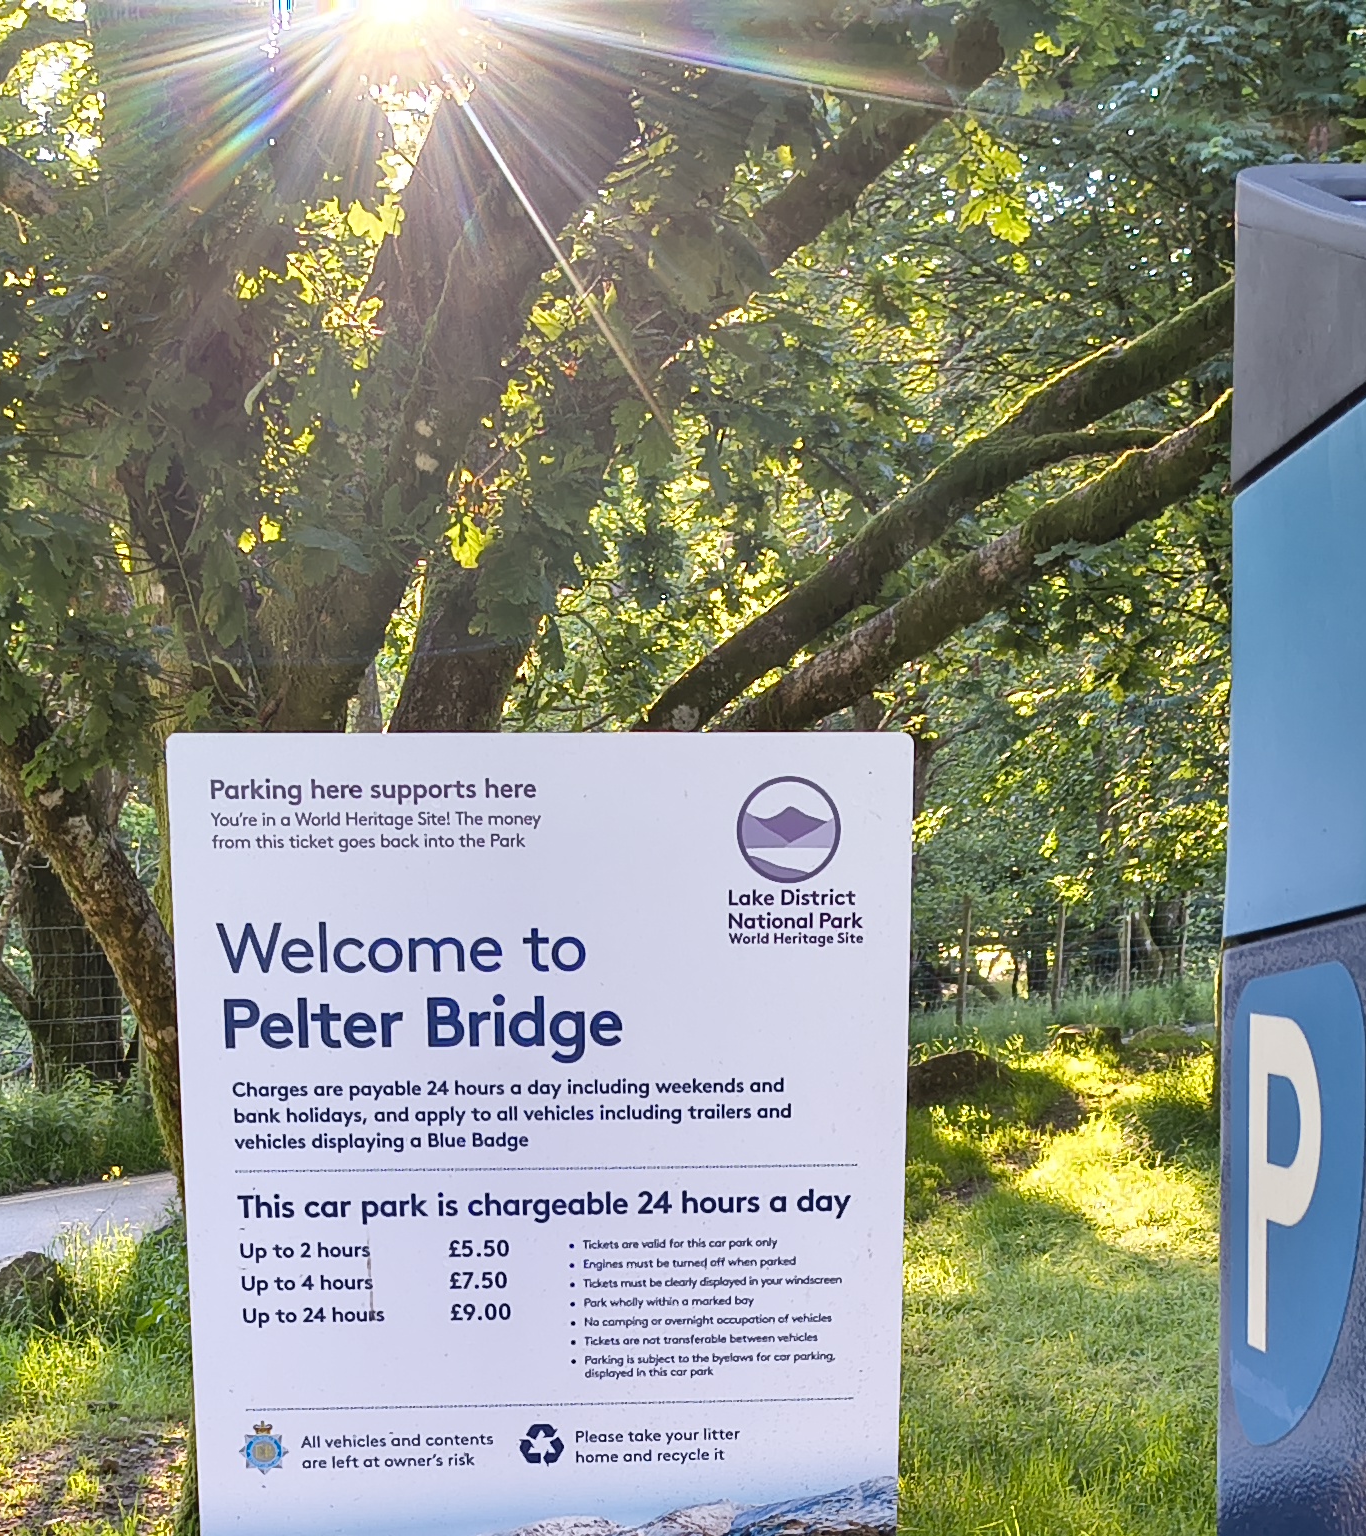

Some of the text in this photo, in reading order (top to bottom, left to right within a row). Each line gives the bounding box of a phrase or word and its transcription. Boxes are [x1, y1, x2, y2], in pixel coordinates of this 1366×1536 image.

[210, 777, 537, 806] Parking here supports here
[210, 810, 541, 831] You're in a World Heritage Site! The money
[211, 832, 526, 853] from this ticket goes back into the Park
[728, 888, 856, 906] Lake District
[728, 911, 863, 929] National Park
[215, 921, 586, 974] Welcome to
[728, 931, 863, 947] World Heritage Site
[223, 993, 623, 1063] Pelter Bridge
[232, 1076, 784, 1102] Charges are payable 24 hours a day including weekends and
[233, 1102, 792, 1127] bank holidays, and apply to all vehicles including trailers and
[234, 1131, 529, 1153] vehicles displaying a Blue Badge
[1247, 1012, 1322, 1353] P
[236, 1188, 851, 1225] This car park is chargeable 24 hours a day
[239, 1239, 509, 1264] Up to 2 hours £5.50
[582, 1237, 777, 1250] Tickets are valid for this car park only
[241, 1271, 507, 1296] Up to 4 hours £7.50
[242, 1302, 511, 1328] Up to 24 hours £9.00
[300, 1433, 494, 1448] All vehicles and contents
[575, 1427, 740, 1445] Please take your litter
[301, 1452, 475, 1469] are left at owner's risk
[575, 1447, 725, 1465] home and recycle it
